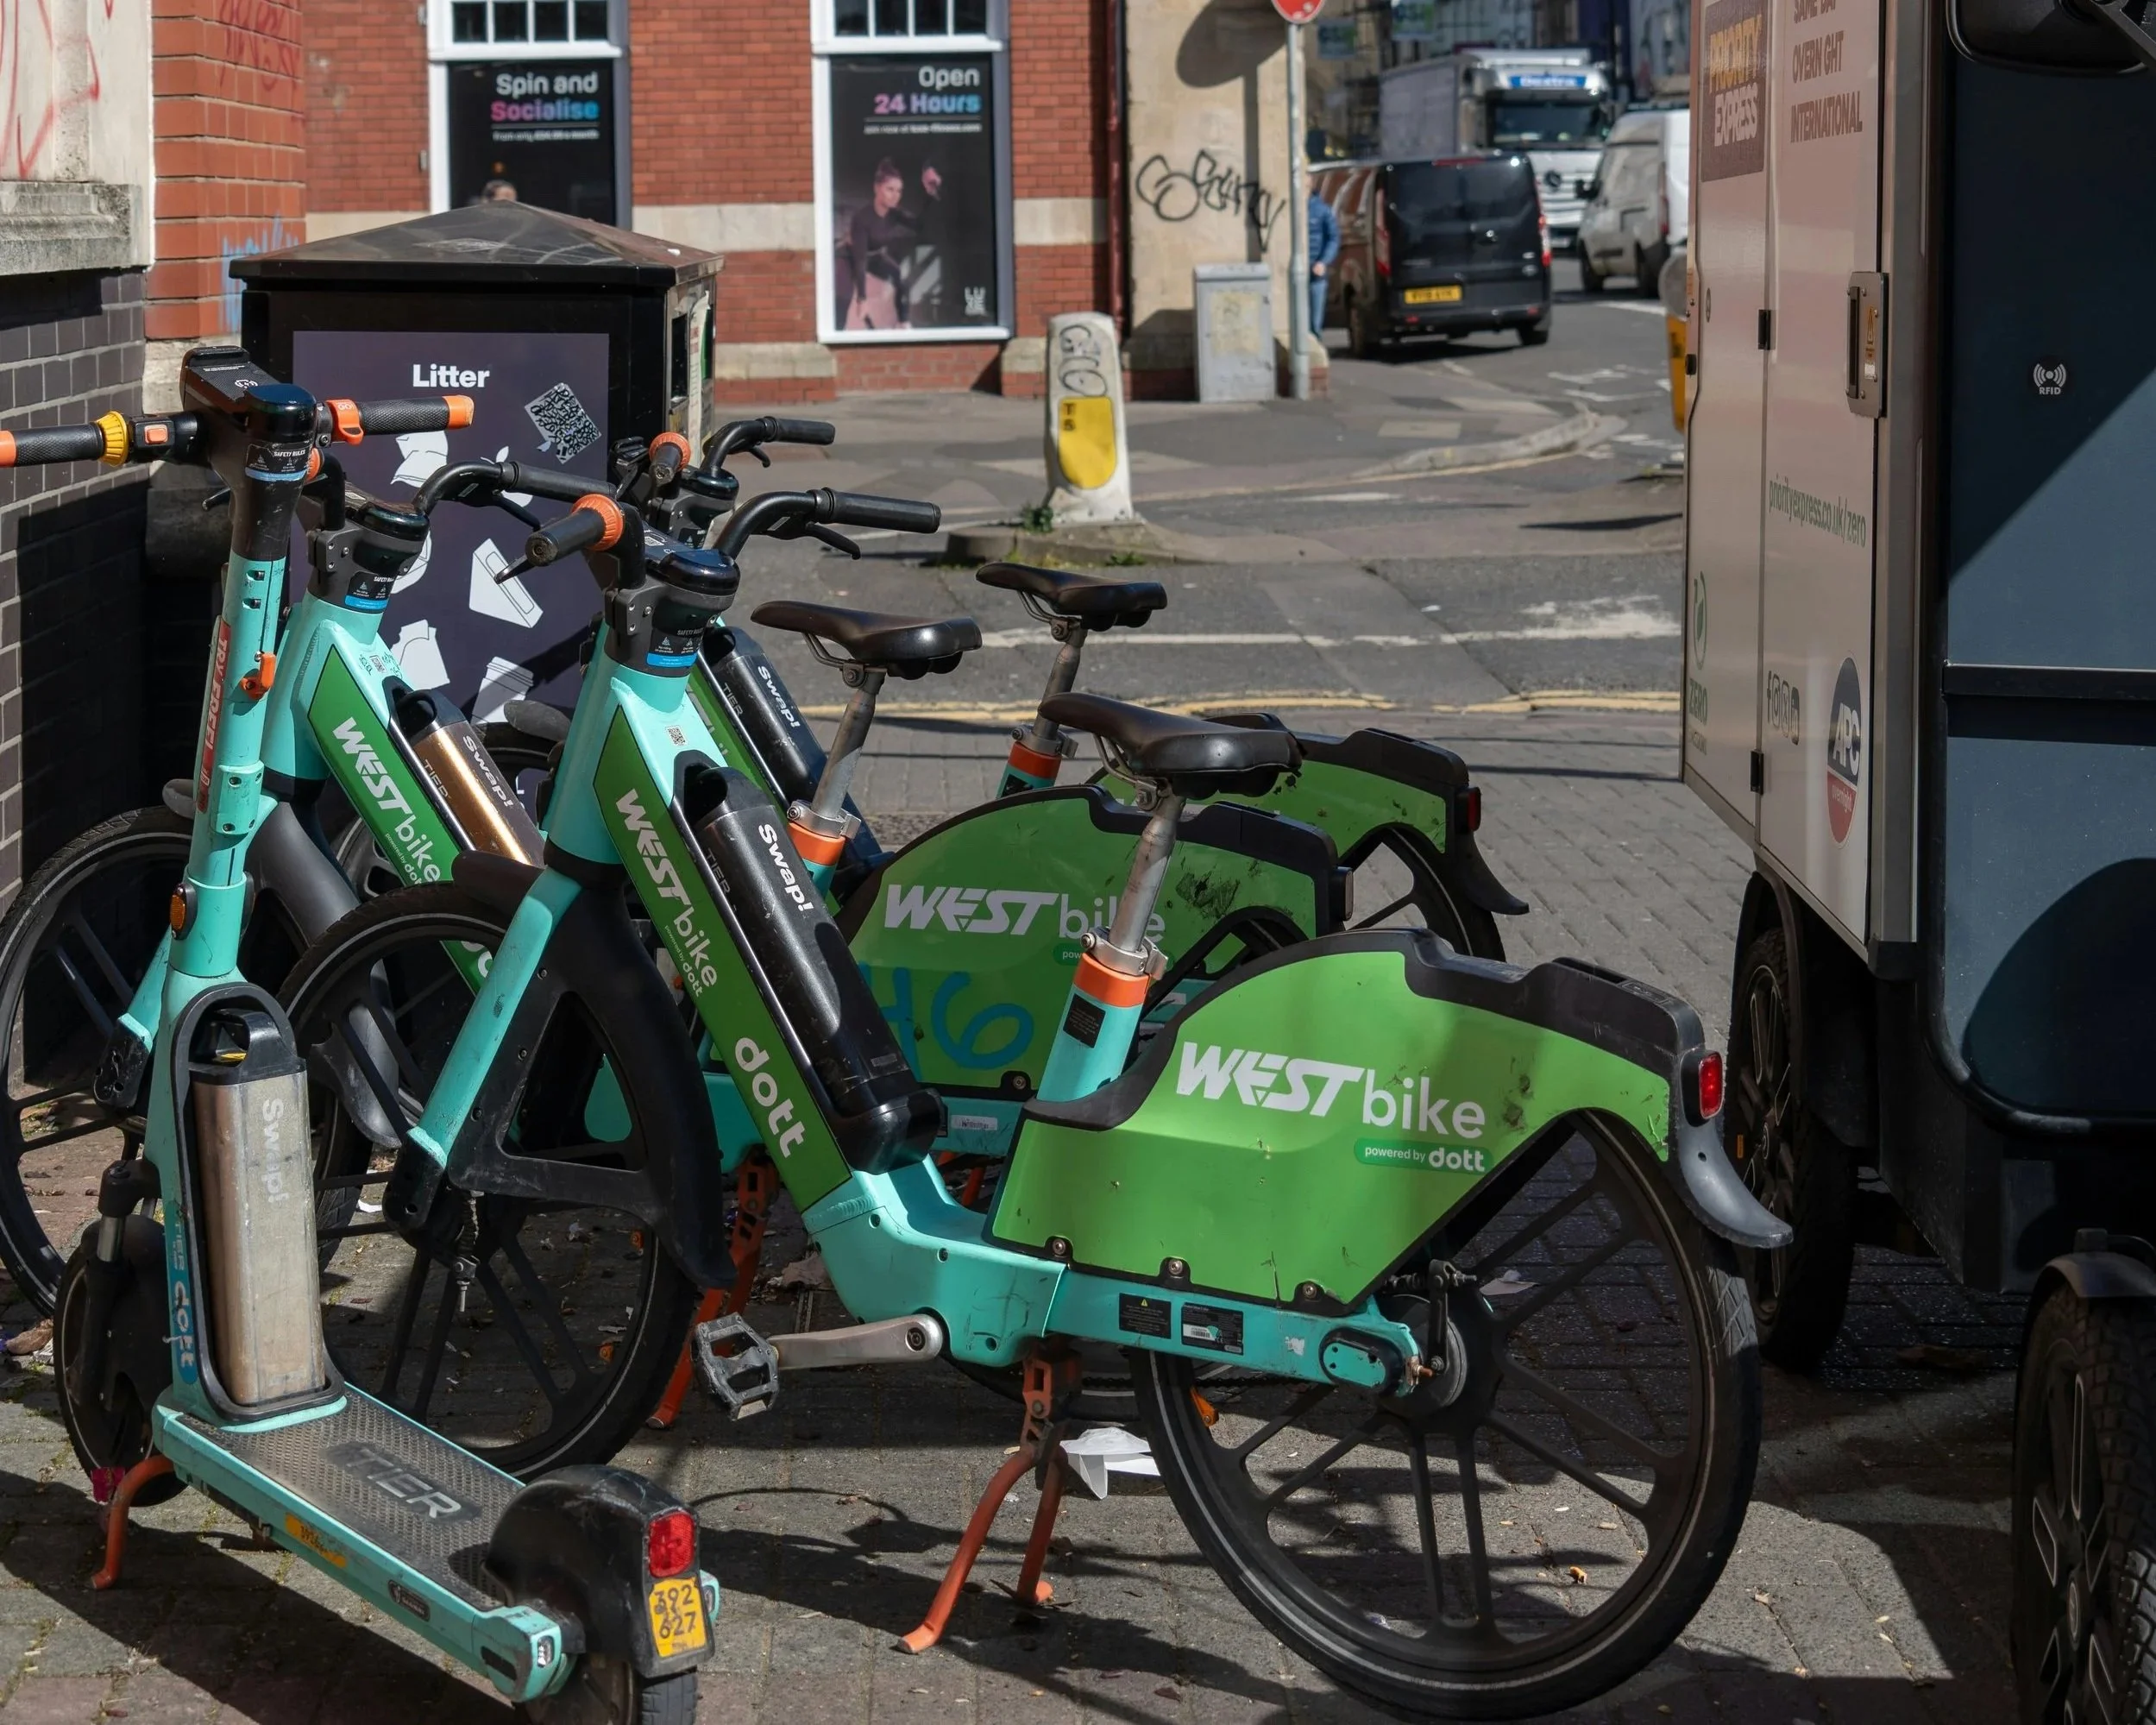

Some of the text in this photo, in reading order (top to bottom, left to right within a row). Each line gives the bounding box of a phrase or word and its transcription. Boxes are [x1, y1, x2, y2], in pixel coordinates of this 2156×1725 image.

[1709, 15, 1762, 94] PRIORITY
[496, 72, 598, 98] Spin and
[919, 66, 980, 91] Open
[491, 98, 599, 121] Socialise
[874, 93, 981, 114] 24 Hours
[1714, 83, 1758, 146] EXPRESS
[1790, 91, 1863, 143] INTERNATIONAL
[413, 363, 490, 387] Litter
[215, 639, 228, 678] TRY
[722, 683, 743, 715] TIER
[758, 666, 800, 727] Swap!
[1689, 677, 1707, 725] ZERO
[1833, 702, 1860, 776] APC
[463, 735, 513, 807] Swap!
[1832, 784, 1852, 812] overnight
[385, 833, 402, 857] powered
[400, 853, 406, 863] by
[706, 848, 731, 893] TIER
[758, 824, 814, 911] Swap!
[664, 925, 704, 997] powered by dott
[735, 1037, 805, 1158] dott
[261, 1099, 289, 1203] Swap!
[1365, 1147, 1485, 1172] powered by dott
[175, 1223, 185, 1270] TIER
[175, 1281, 194, 1368] dott
[347, 1449, 462, 1519] TIER
[654, 1584, 694, 1614] 392
[659, 1611, 696, 1640] 627
